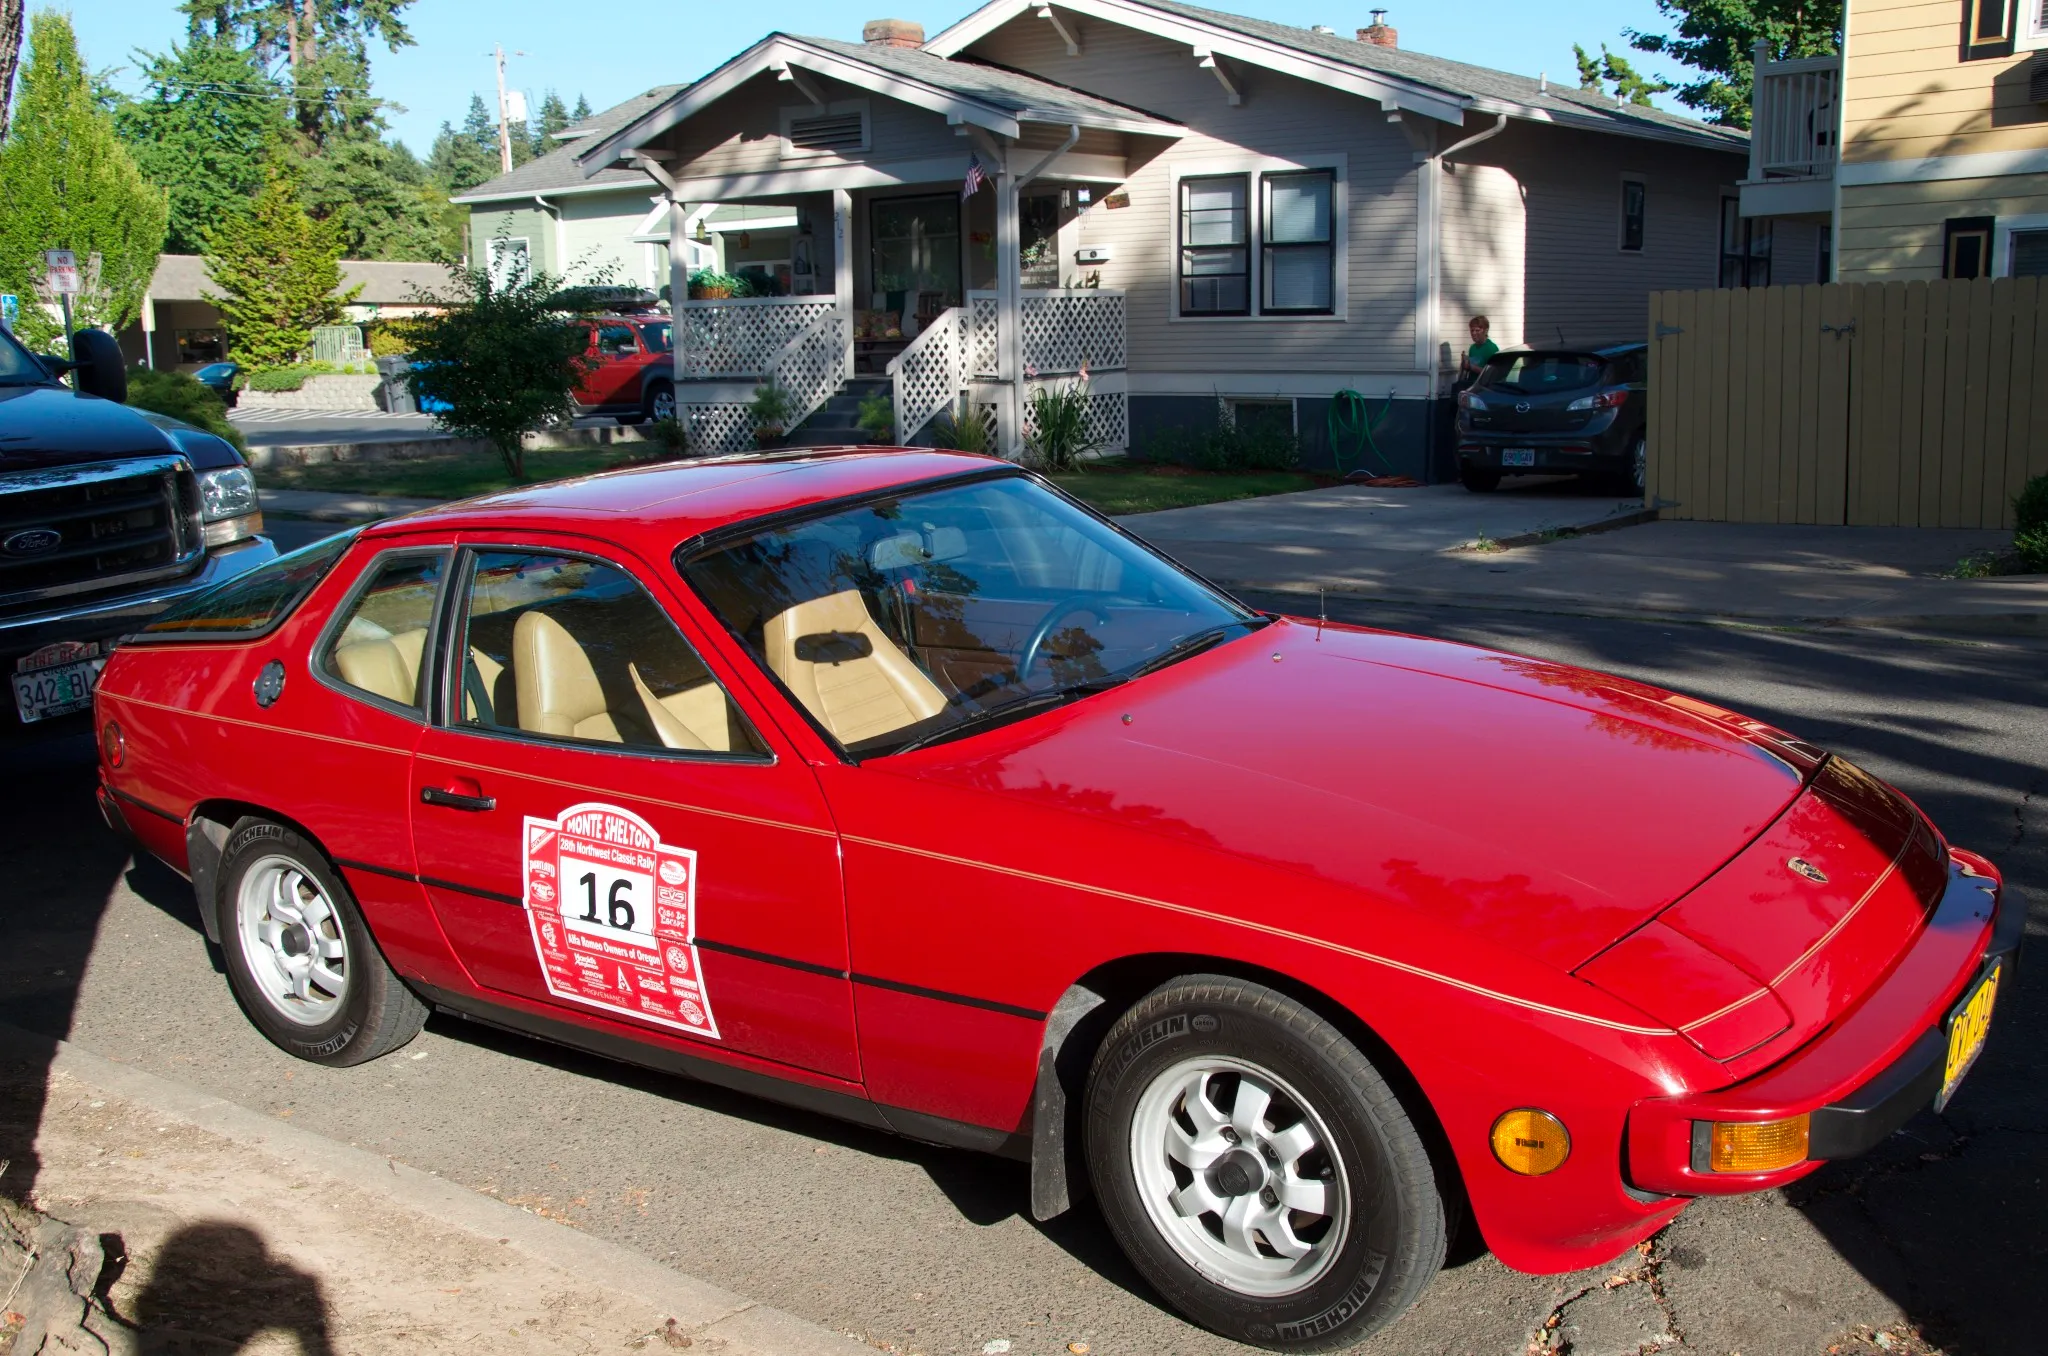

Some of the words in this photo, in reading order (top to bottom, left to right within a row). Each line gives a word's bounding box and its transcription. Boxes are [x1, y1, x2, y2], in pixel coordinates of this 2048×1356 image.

[50, 265, 76, 273] PARKING
[57, 256, 68, 265] NO
[18, 534, 49, 549] Ford
[20, 678, 60, 709] 342
[232, 825, 282, 853] MICHELIN
[566, 813, 603, 839] MONTE
[604, 815, 651, 849] SHELTON
[560, 837, 576, 853] 28th
[576, 841, 611, 861] Northwest
[611, 849, 636, 866] Classic
[637, 854, 655, 873] Rally
[579, 872, 635, 931] 16
[568, 933, 581, 946] Alfa
[581, 936, 603, 951] Romeo
[603, 941, 628, 958] Owners
[629, 949, 636, 959] of
[637, 950, 661, 966] Oregon
[1104, 1015, 1185, 1086] MICHELIN
[1282, 1277, 1372, 1340] MICHELIN
